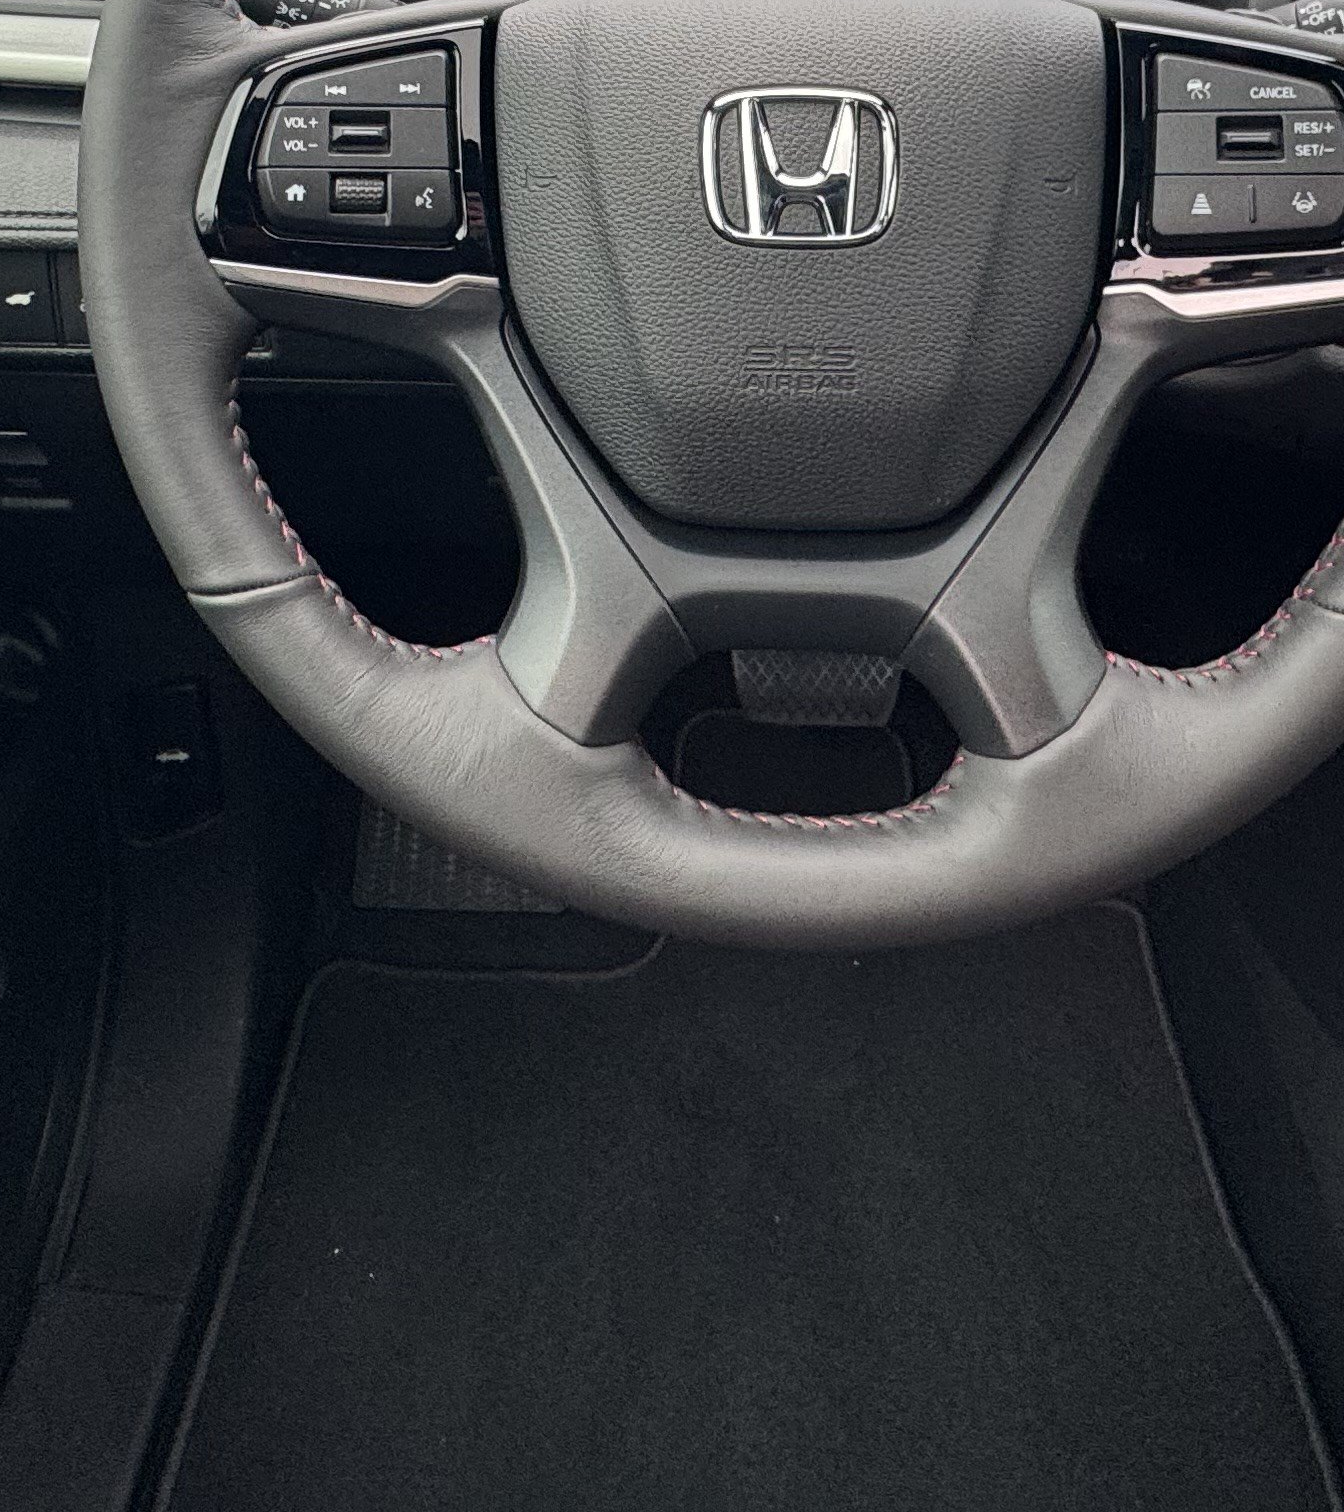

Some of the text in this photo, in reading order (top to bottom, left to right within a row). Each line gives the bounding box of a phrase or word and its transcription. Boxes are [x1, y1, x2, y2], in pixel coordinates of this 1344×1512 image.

[1309, 8, 1336, 26] OFF
[1250, 87, 1297, 100] CANCEL
[745, 345, 856, 369] SRS
